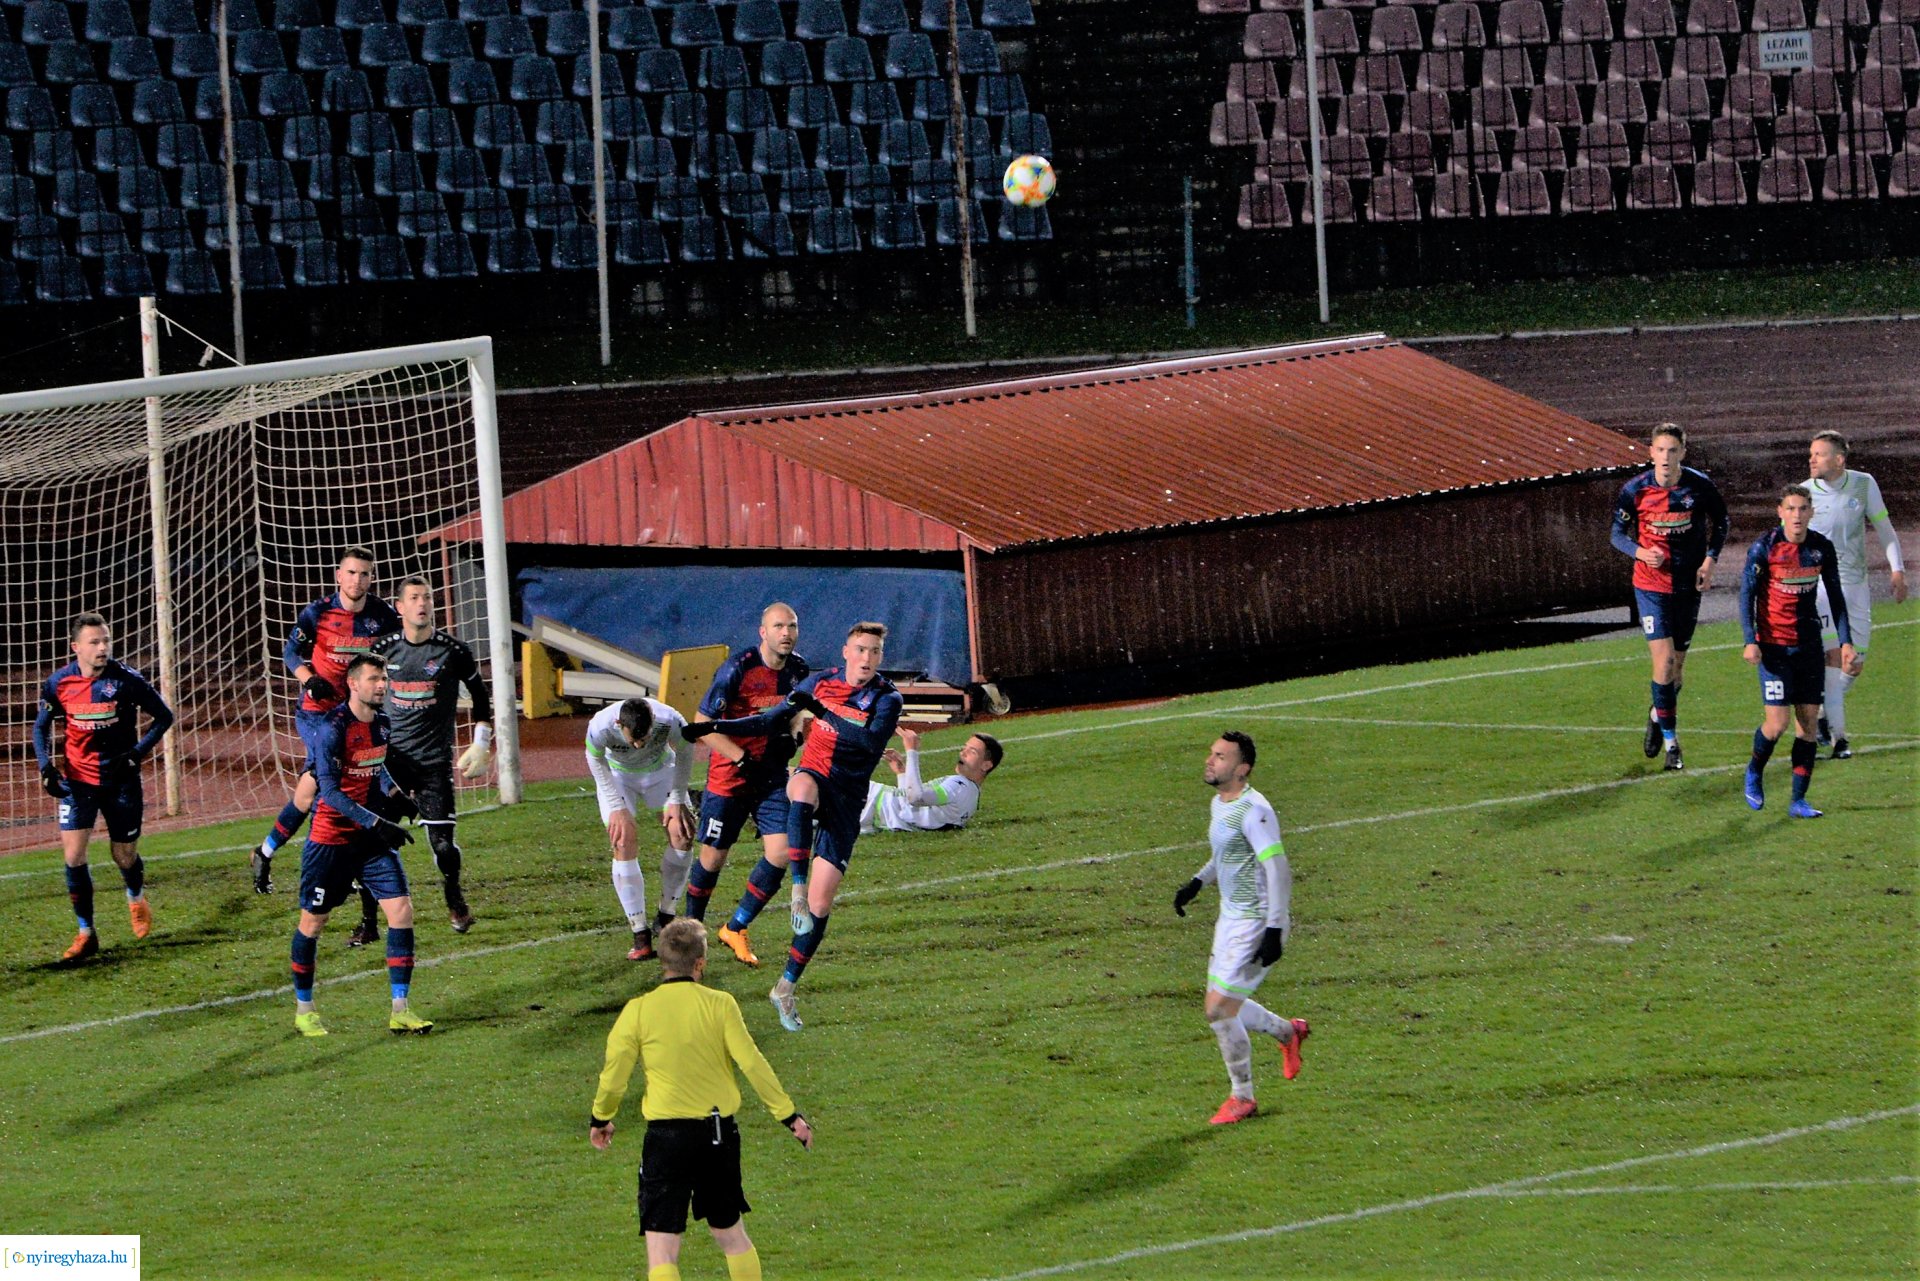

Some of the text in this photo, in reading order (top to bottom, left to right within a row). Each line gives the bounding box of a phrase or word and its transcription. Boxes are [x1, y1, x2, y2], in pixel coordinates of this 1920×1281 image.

[1763, 51, 1809, 63] SZEKTOR
[1764, 680, 1785, 700] 29
[706, 817, 724, 839] 15
[312, 886, 325, 906] 3
